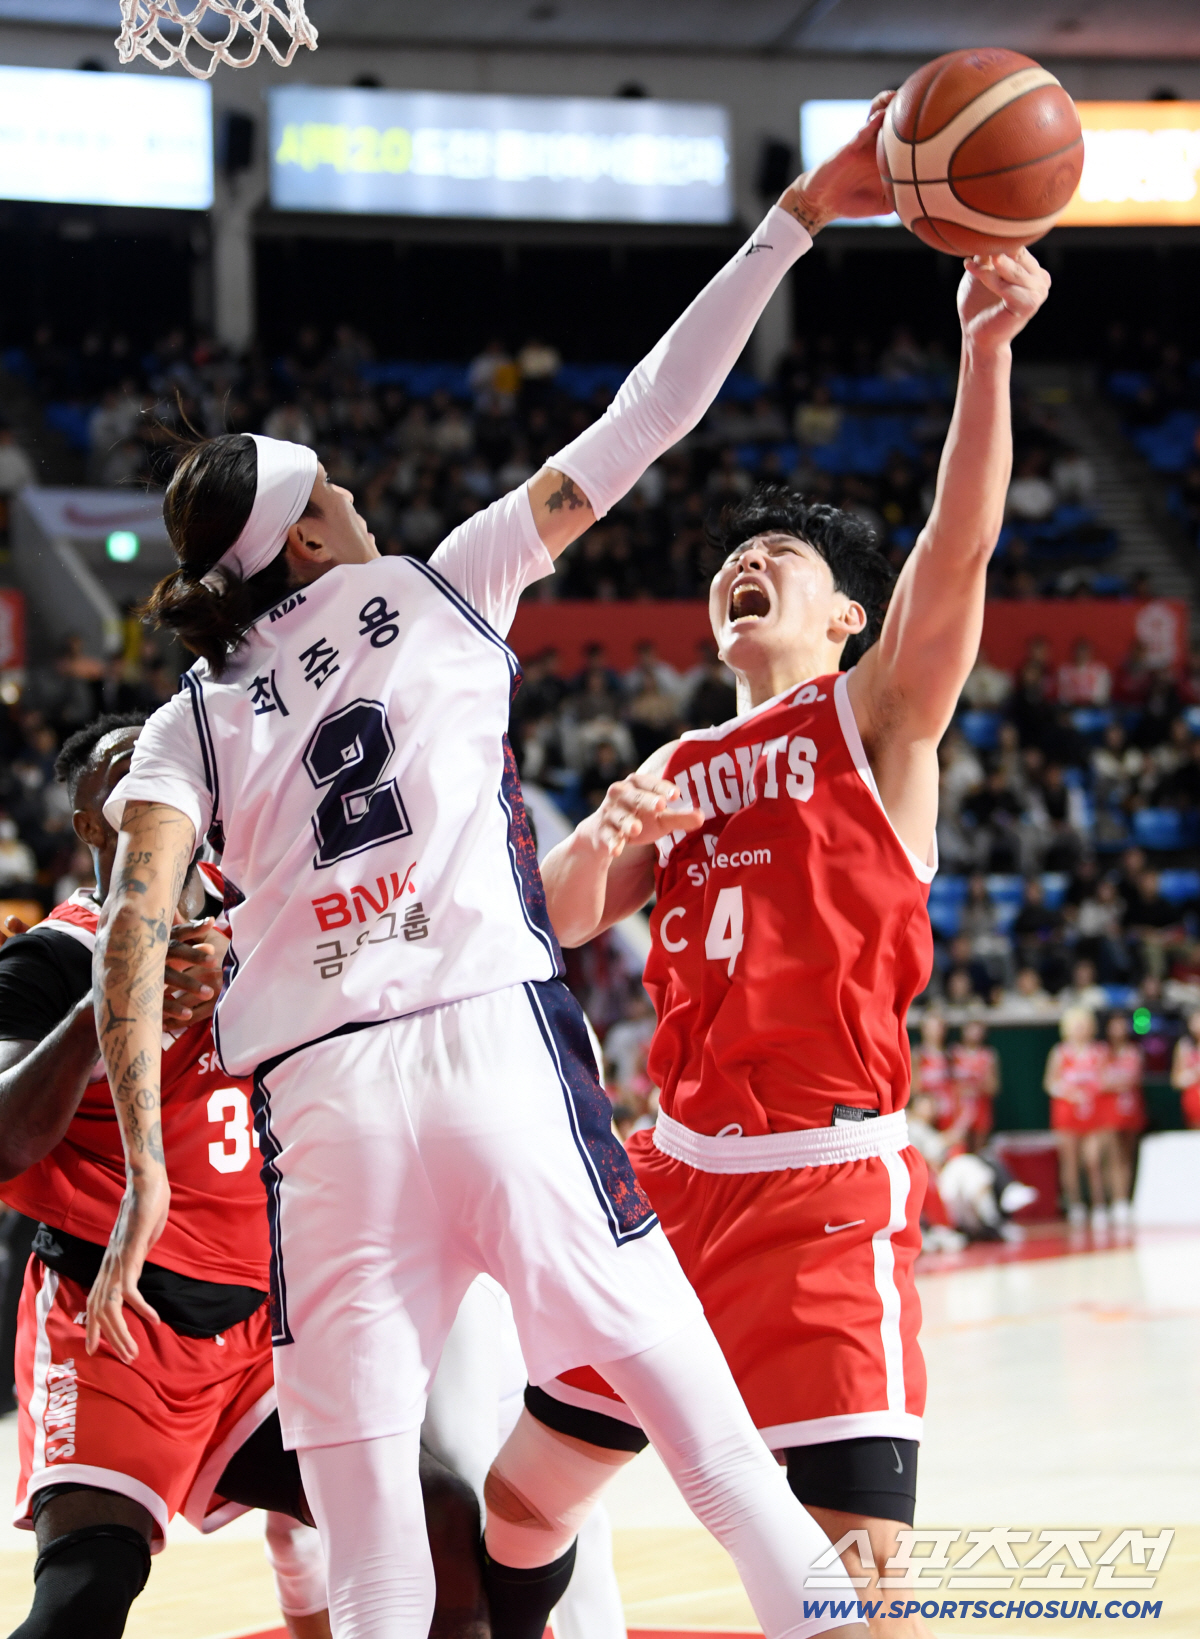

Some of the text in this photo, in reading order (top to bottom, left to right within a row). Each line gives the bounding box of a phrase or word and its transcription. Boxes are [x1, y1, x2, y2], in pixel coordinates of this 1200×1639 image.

[247, 596, 400, 717] 최준용
[302, 698, 413, 870] 2
[660, 907, 688, 952] C
[705, 886, 744, 977] 4
[197, 1051, 223, 1075] SK
[207, 1087, 259, 1174] 3
